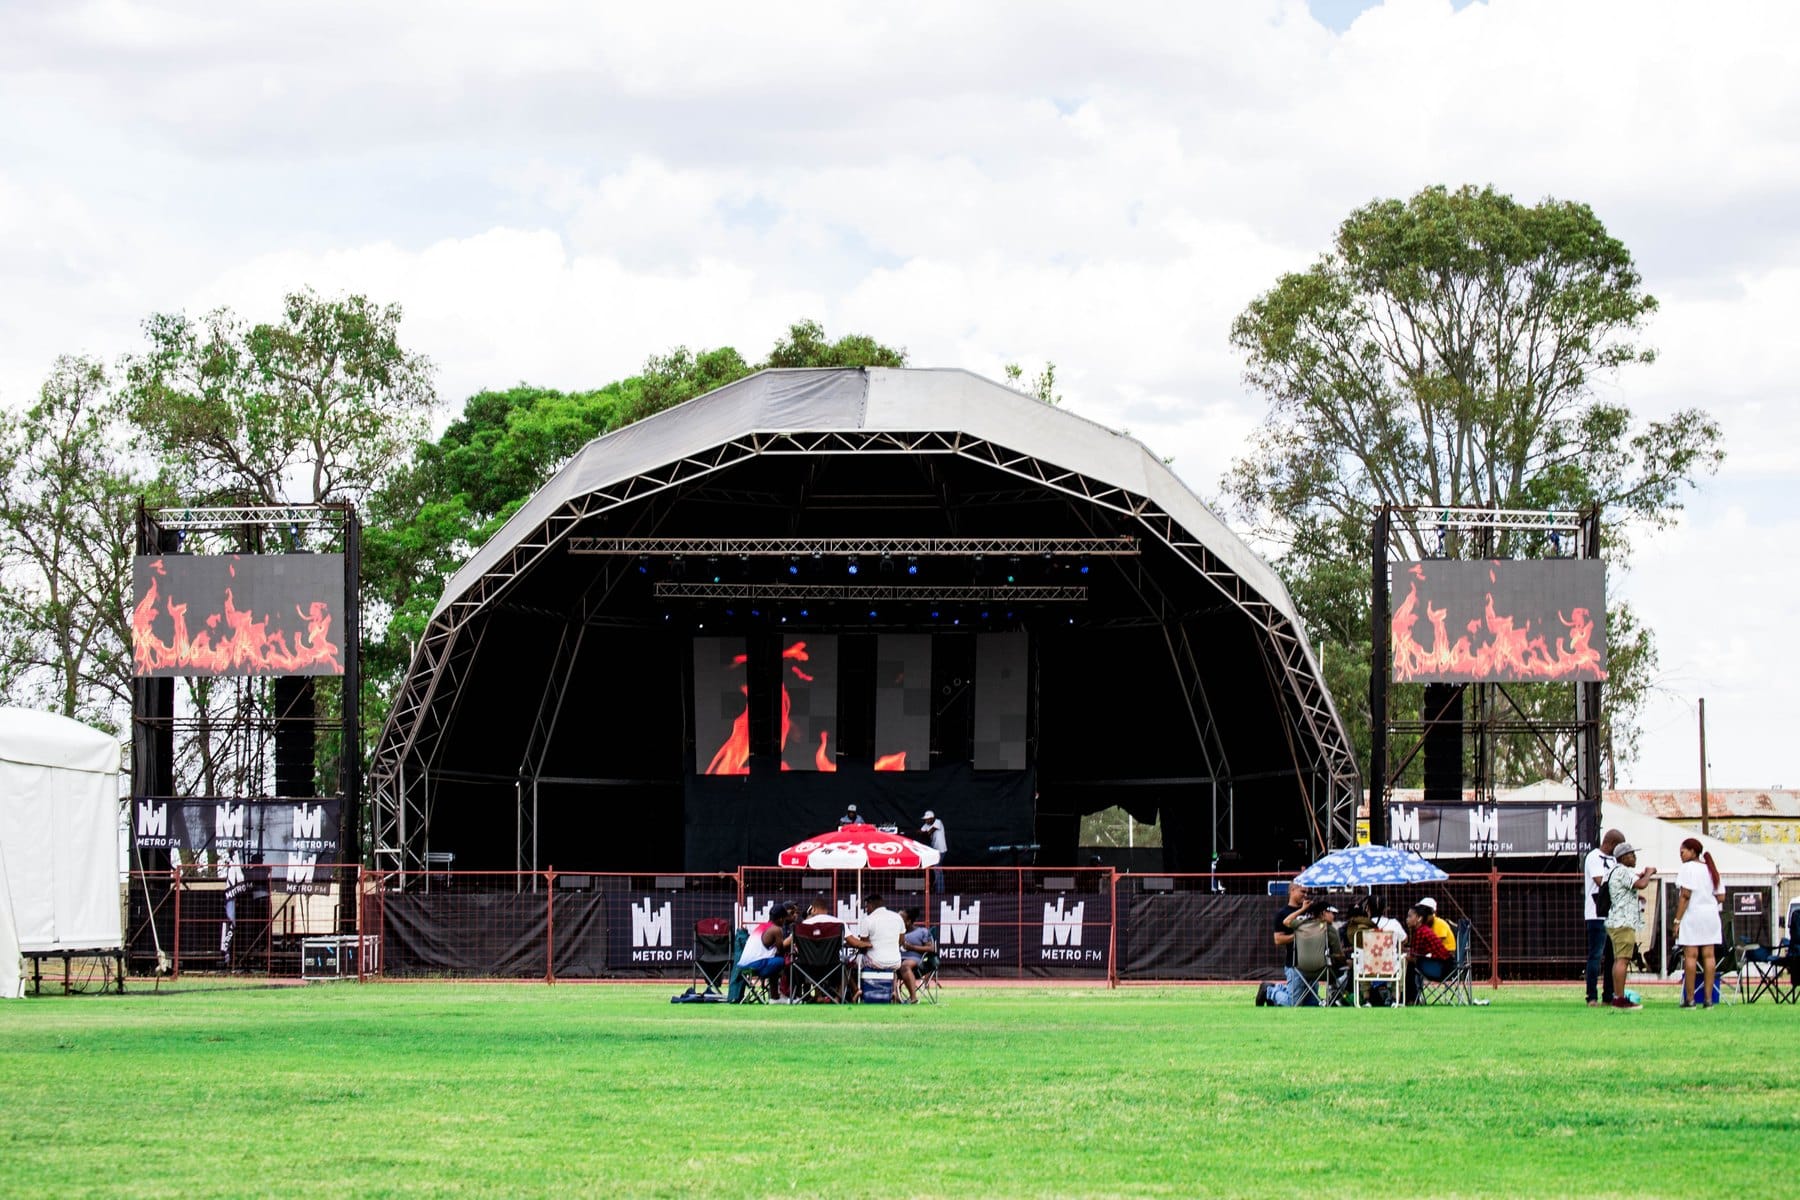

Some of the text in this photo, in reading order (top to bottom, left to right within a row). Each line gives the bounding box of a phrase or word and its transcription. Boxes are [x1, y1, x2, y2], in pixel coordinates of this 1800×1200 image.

[137, 838, 181, 847] METRO FM
[215, 840, 258, 849] METRO FM
[293, 841, 336, 849] METRO FM
[1391, 842, 1435, 850] METRO FM
[1469, 842, 1513, 851] METRO FM
[1547, 842, 1591, 851] METRO FM
[887, 857, 902, 865] OLA
[286, 884, 313, 893] METRO
[632, 950, 693, 961] METRO FM
[939, 948, 1000, 959] METRO FM
[1042, 949, 1102, 961] METRO FM
